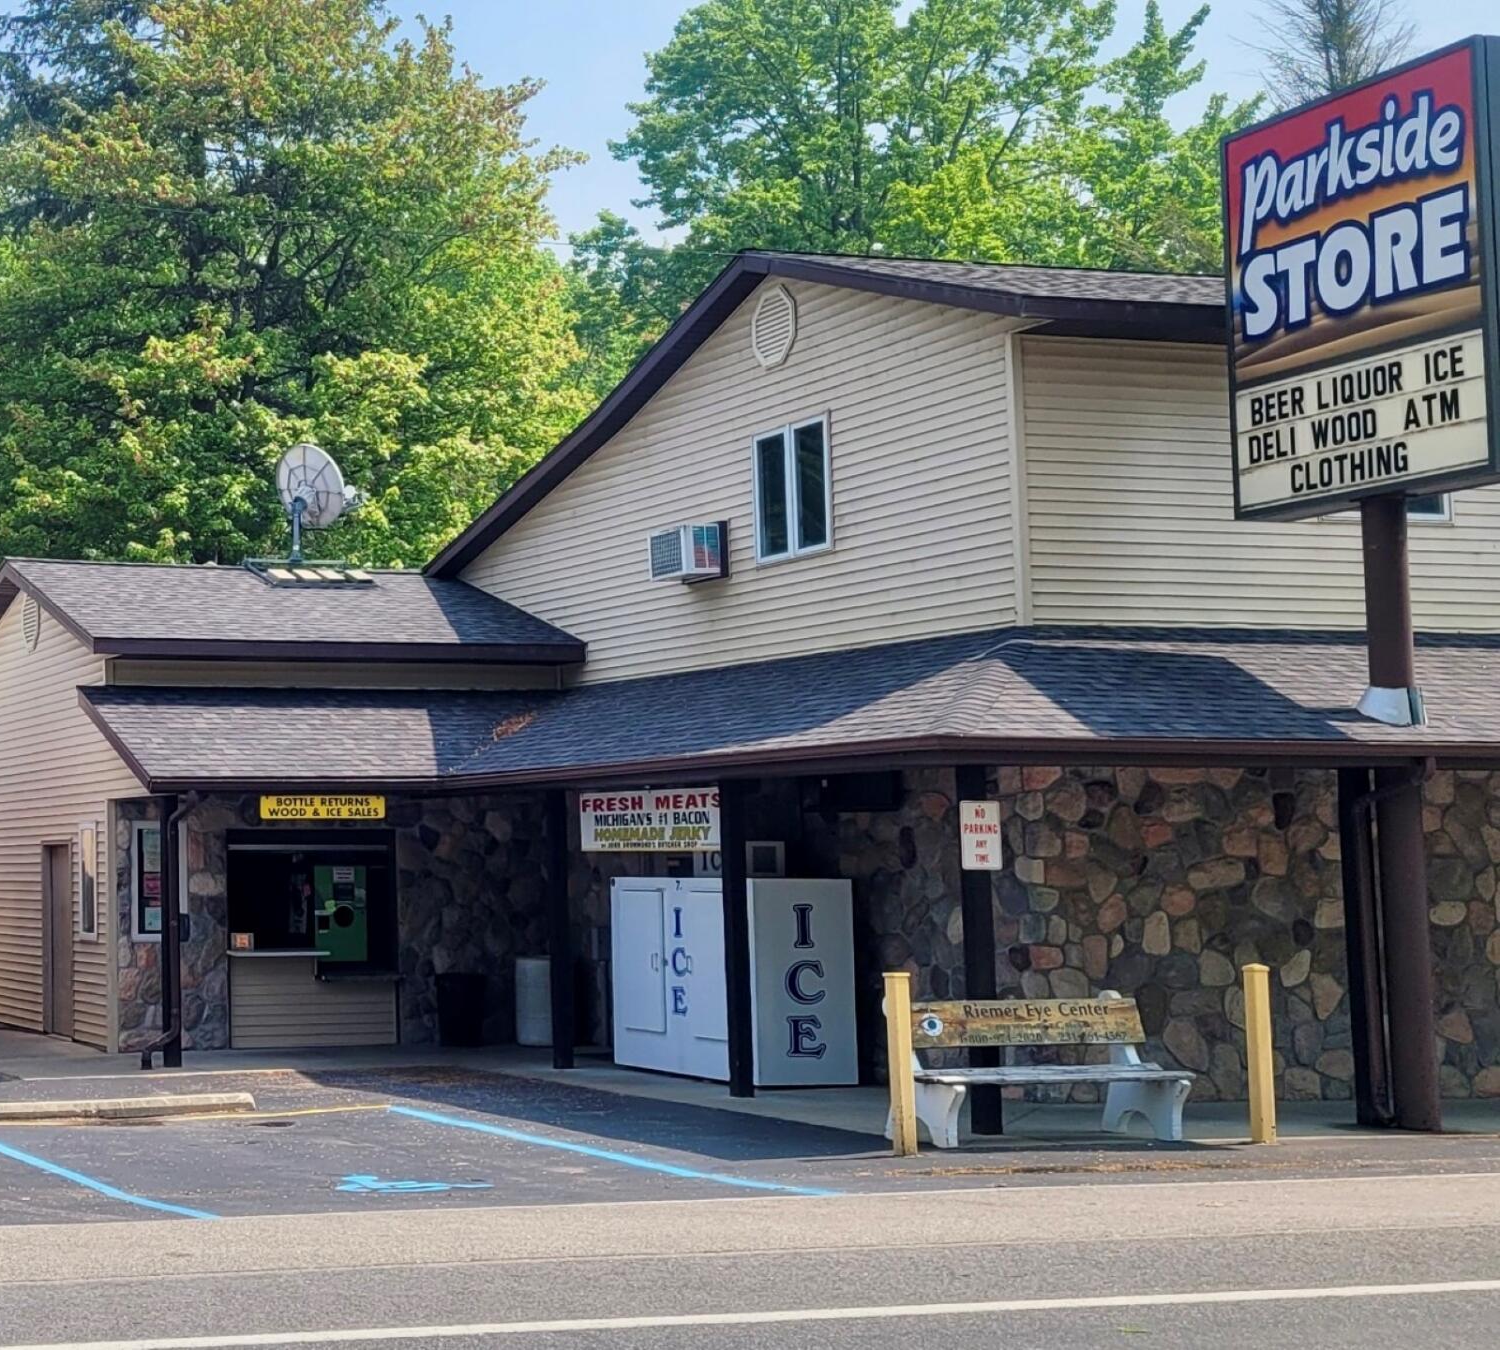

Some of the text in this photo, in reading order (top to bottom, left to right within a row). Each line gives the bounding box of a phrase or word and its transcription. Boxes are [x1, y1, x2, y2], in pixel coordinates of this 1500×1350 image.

[1240, 93, 1462, 256] Parkside
[1242, 189, 1466, 337] STORE
[1251, 345, 1464, 428] BEER LIQUOR ICE
[1248, 388, 1460, 465] DELI WOOD ATM
[1290, 441, 1409, 494] CLOTHING
[268, 807, 379, 817] WOOD & ICE SALES
[276, 797, 370, 807] BOTTLE RETURNS
[581, 793, 720, 813] FRESH MEATS
[594, 813, 652, 827] MICHIGAN'S
[673, 810, 710, 826] BACON
[974, 807, 986, 819] NO
[593, 826, 712, 842] HOMEMADE JERKY
[963, 823, 998, 835] PARKING
[975, 839, 988, 848] ANY
[974, 853, 990, 863] TIME
[671, 906, 688, 1017] ICE
[784, 903, 826, 1060] ICE
[963, 1001, 1110, 1021] Riemer Eye Center
